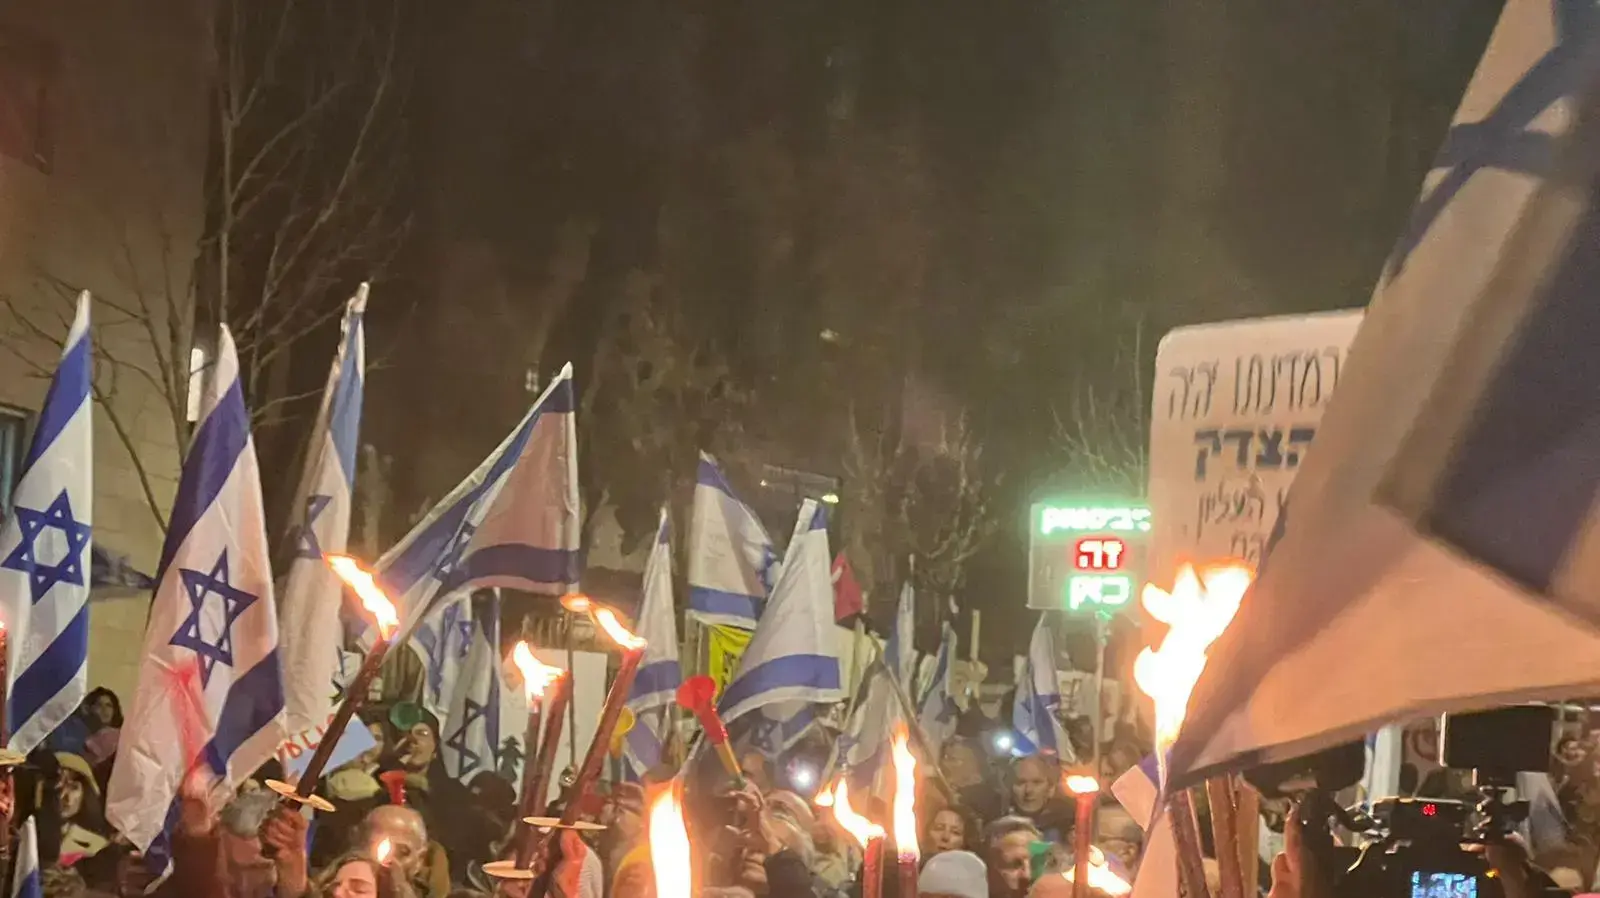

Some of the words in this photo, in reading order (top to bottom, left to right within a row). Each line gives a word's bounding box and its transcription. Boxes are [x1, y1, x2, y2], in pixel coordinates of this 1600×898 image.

[1169, 358, 1219, 420] יהיה
[1193, 429, 1315, 482] הצדק
[1079, 540, 1123, 568] זה
[1069, 576, 1130, 610] כאן
